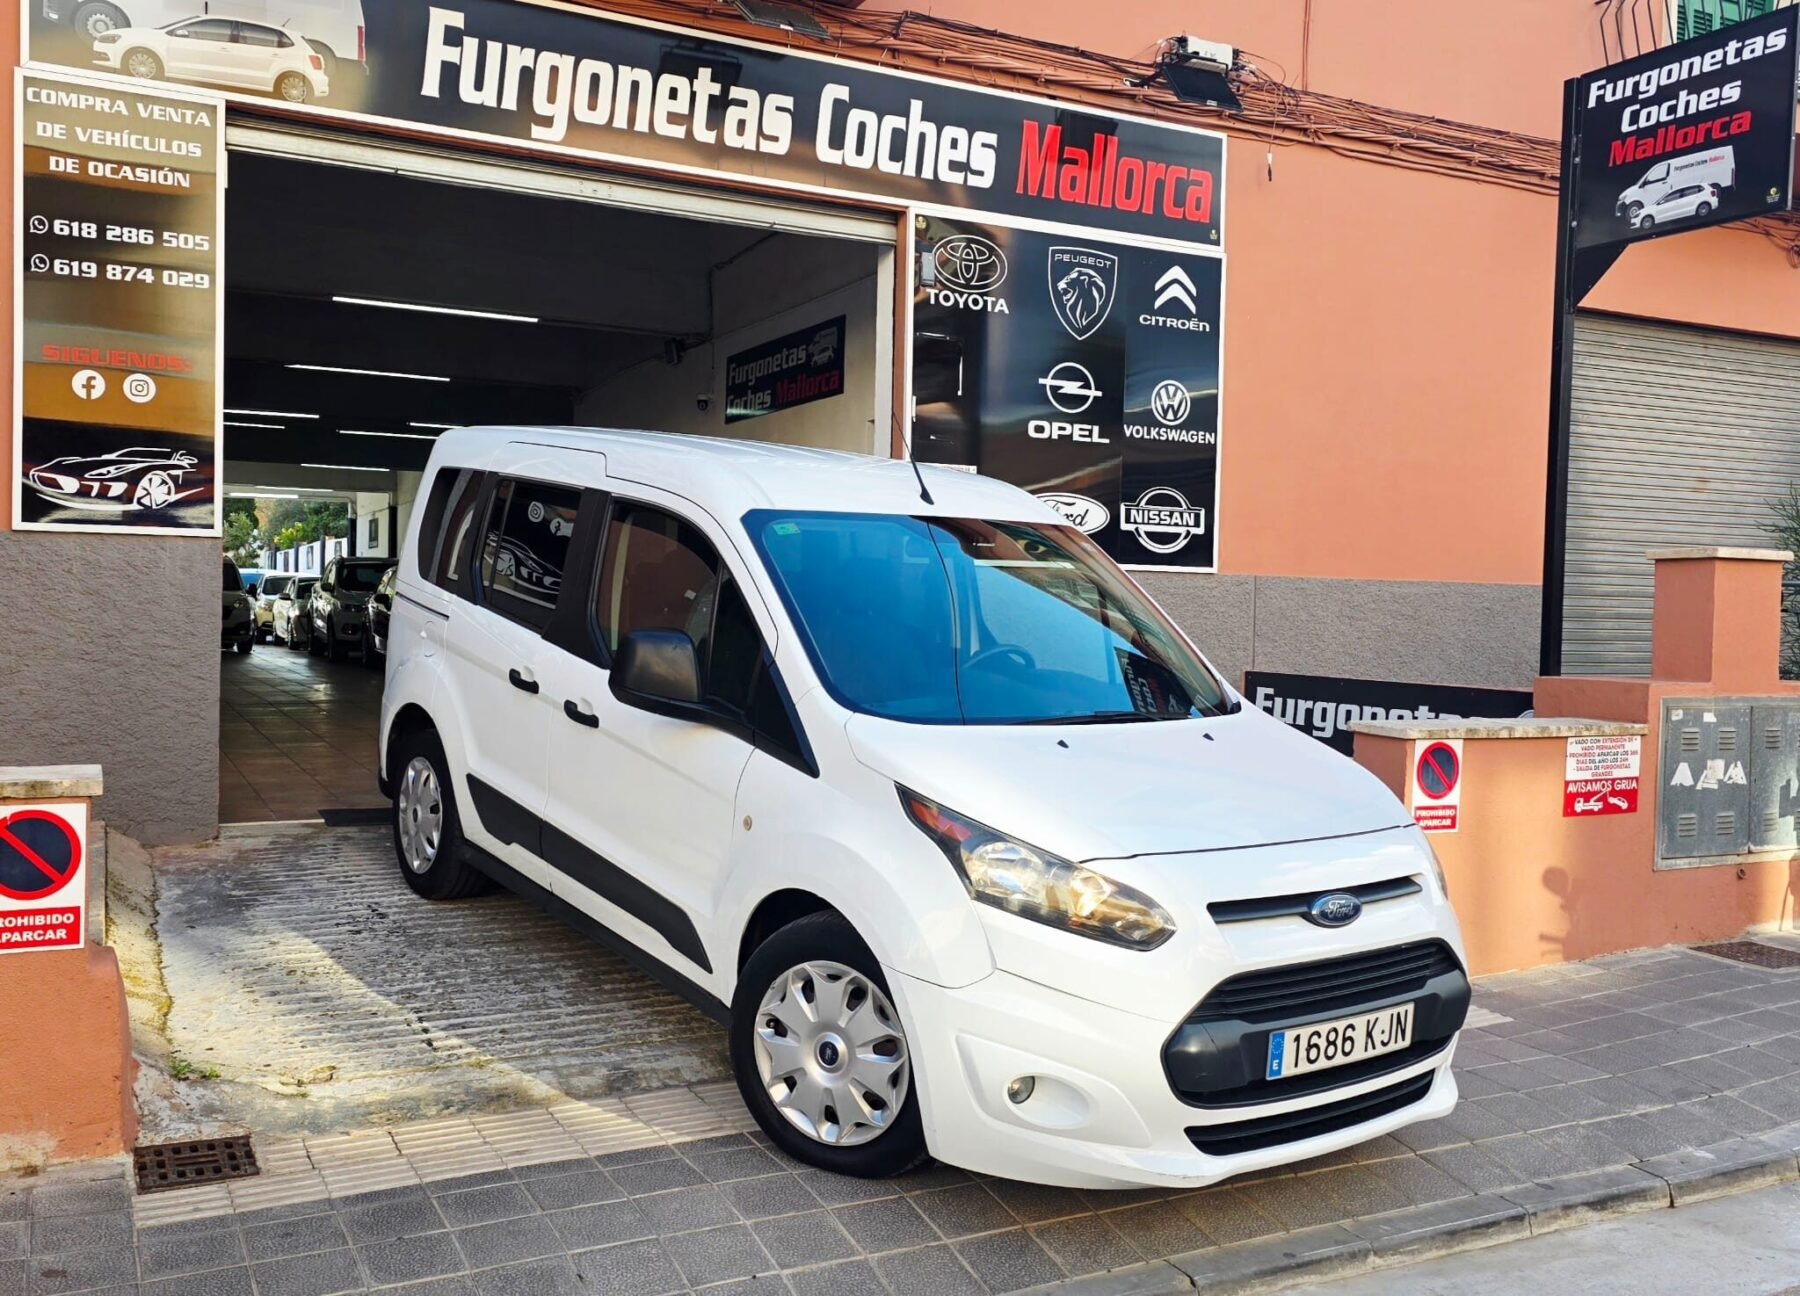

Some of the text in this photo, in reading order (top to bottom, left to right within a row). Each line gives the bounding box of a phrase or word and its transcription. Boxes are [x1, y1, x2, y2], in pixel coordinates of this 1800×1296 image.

[1587, 27, 1787, 109] Furgonetas
[26, 87, 211, 127] COMPRA VENTA
[420, 6, 1213, 224] Furgonetas Coches Mallorca
[1621, 80, 1742, 133] Coches
[36, 121, 202, 158] DE VEHÍCULOS
[1608, 110, 1752, 167] Mallorca
[49, 156, 190, 188] DE OCASIÓN
[53, 219, 210, 251] 618 286 505
[53, 258, 210, 289] 619 874 029
[1054, 252, 1112, 269] PEUGEOT
[926, 288, 1010, 314] TOYOTA
[728, 344, 807, 386] Furgonetas
[775, 369, 840, 405] Mallorca
[1027, 420, 1110, 444] OPEL
[1123, 424, 1215, 445] VOLKSWAGEN
[1130, 508, 1195, 527] NISSAN
[1567, 779, 1638, 794] AVISAMOS GRUA
[1415, 808, 1456, 817] PROHIBIDO
[1324, 899, 1354, 919] Ford
[0, 928, 68, 944] PARCAR
[1293, 1023, 1356, 1069] 1686
[1272, 1059, 1280, 1071] E
